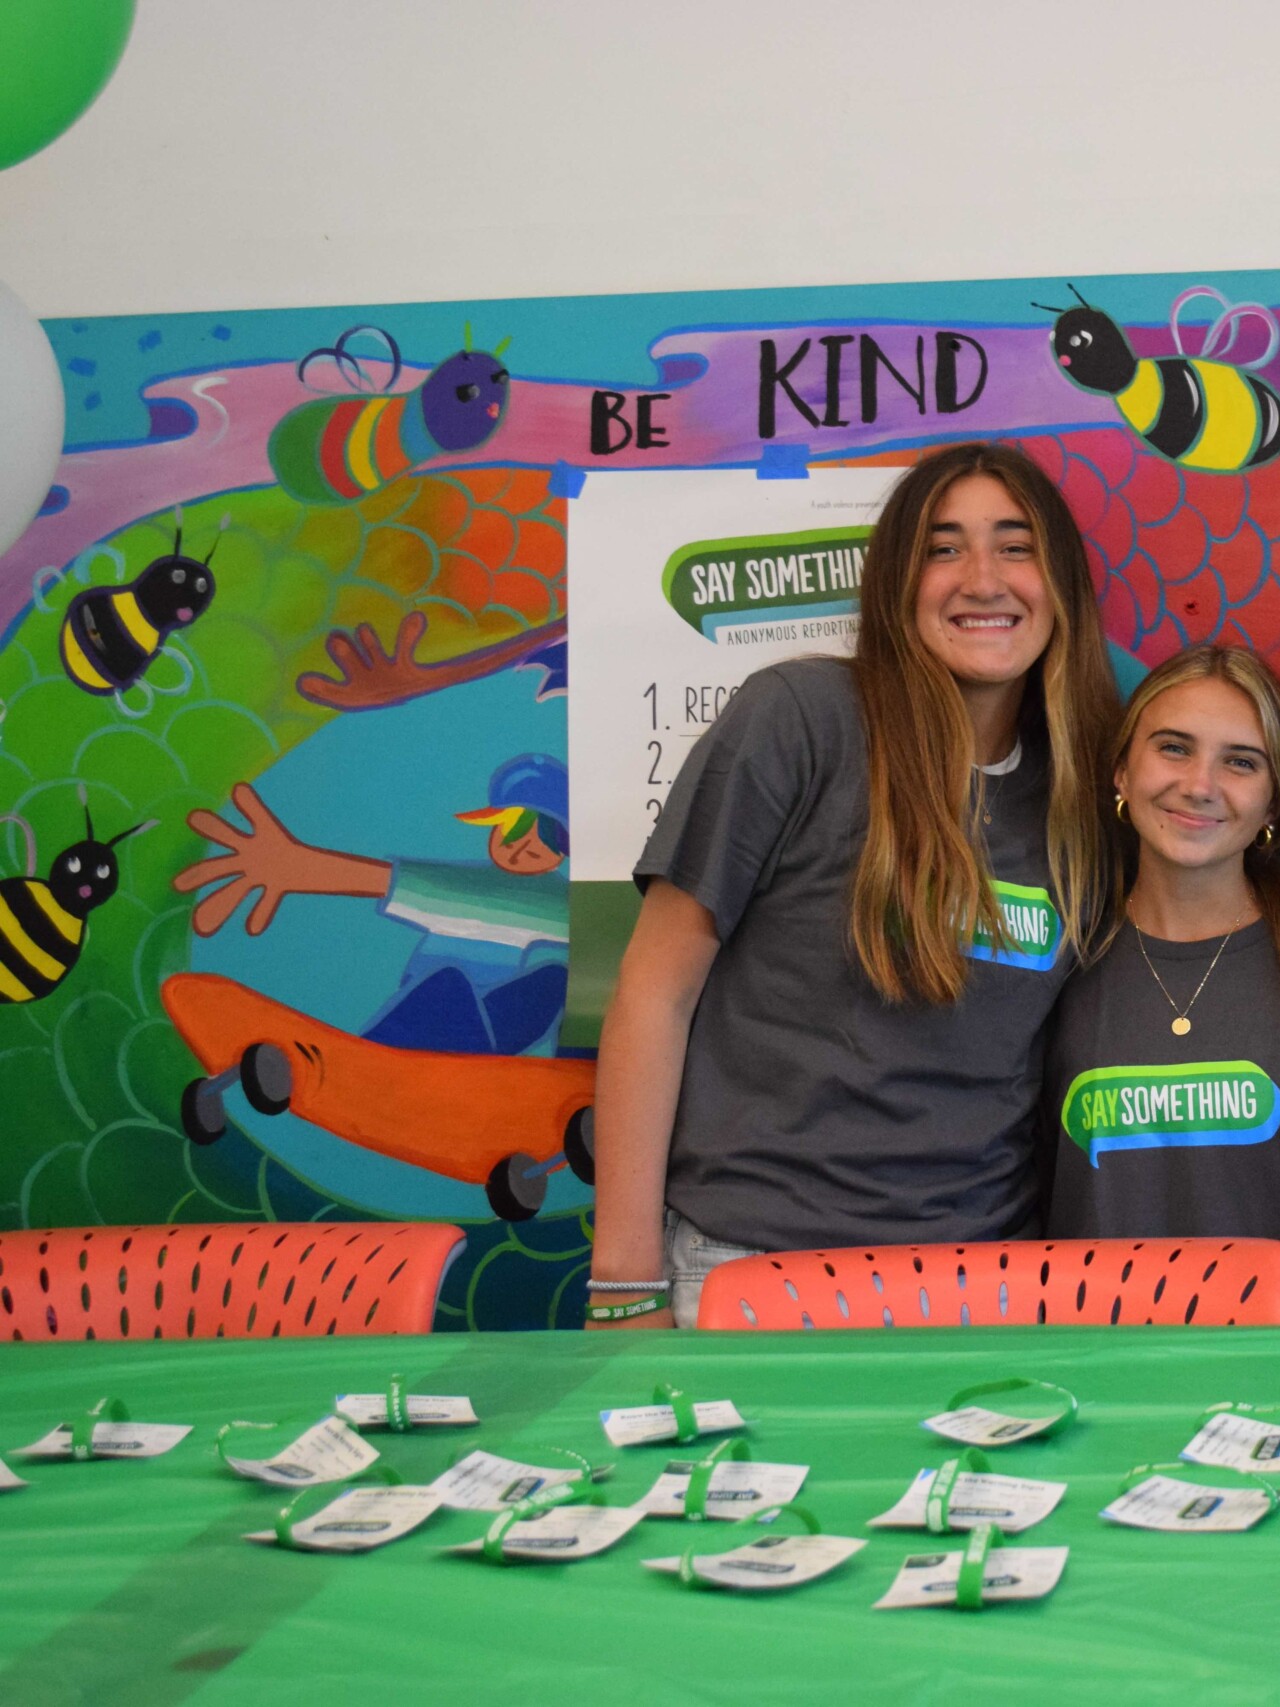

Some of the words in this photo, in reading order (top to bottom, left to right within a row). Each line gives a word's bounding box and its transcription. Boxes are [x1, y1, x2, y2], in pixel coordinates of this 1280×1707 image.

[590, 389, 671, 455] BE
[758, 331, 988, 439] KIND
[691, 561, 735, 605] SAY
[746, 547, 869, 601] SOMETHIN
[727, 625, 797, 646] ANONYMOUS
[643, 682, 671, 731] 1.
[647, 740, 672, 785] 2.
[613, 1308, 625, 1318] SAY
[626, 1299, 657, 1315] SOMETHING
